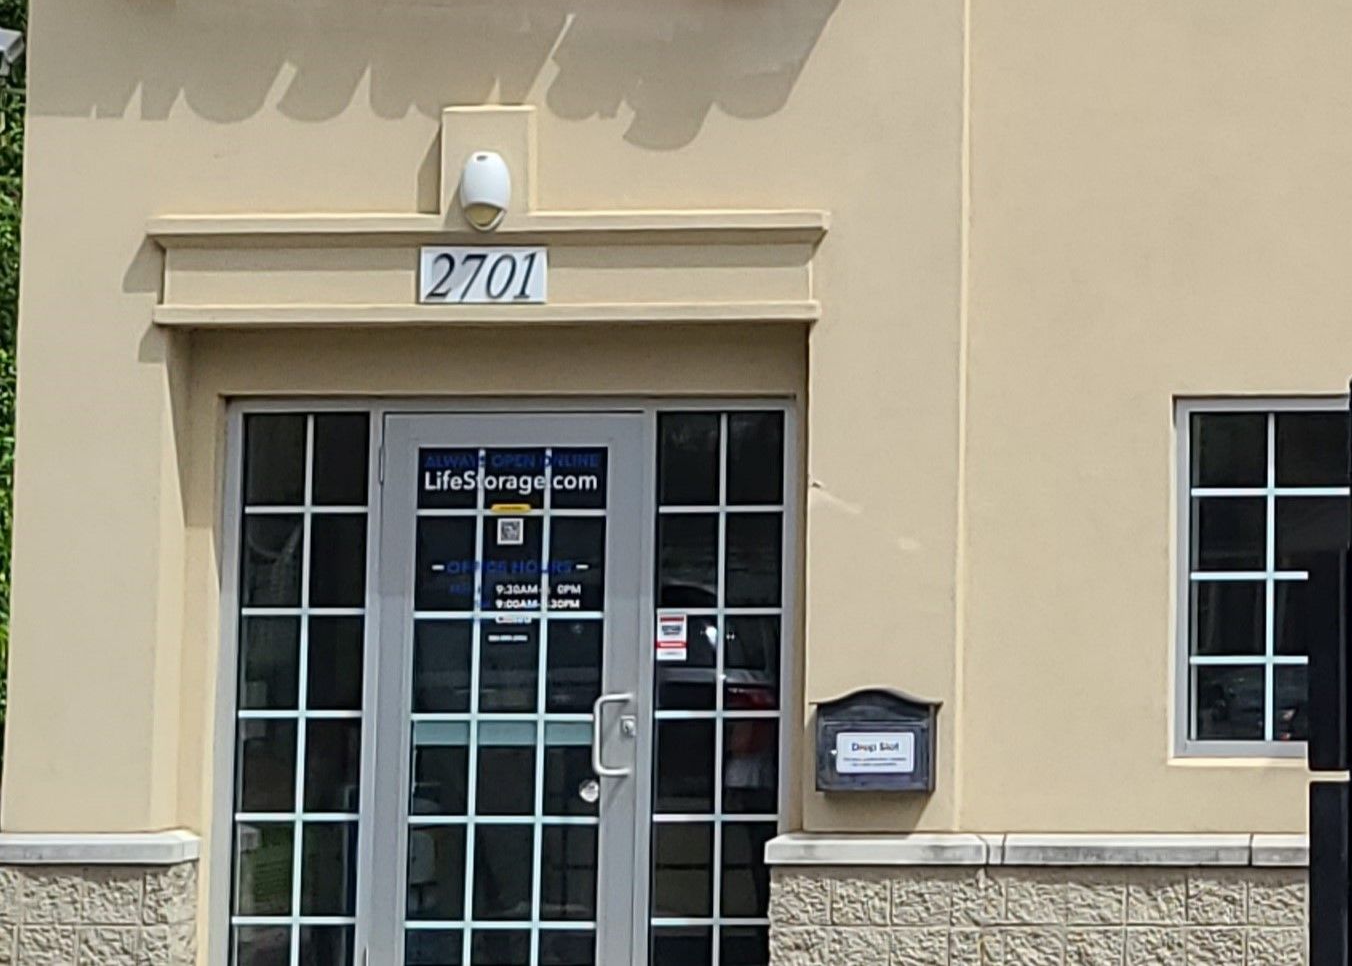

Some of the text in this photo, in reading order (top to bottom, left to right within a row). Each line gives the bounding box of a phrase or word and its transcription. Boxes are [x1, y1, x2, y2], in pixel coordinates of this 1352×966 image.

[425, 251, 537, 302] 2701
[491, 453, 536, 467] OPEN
[423, 469, 599, 495] LifeSoragecom
